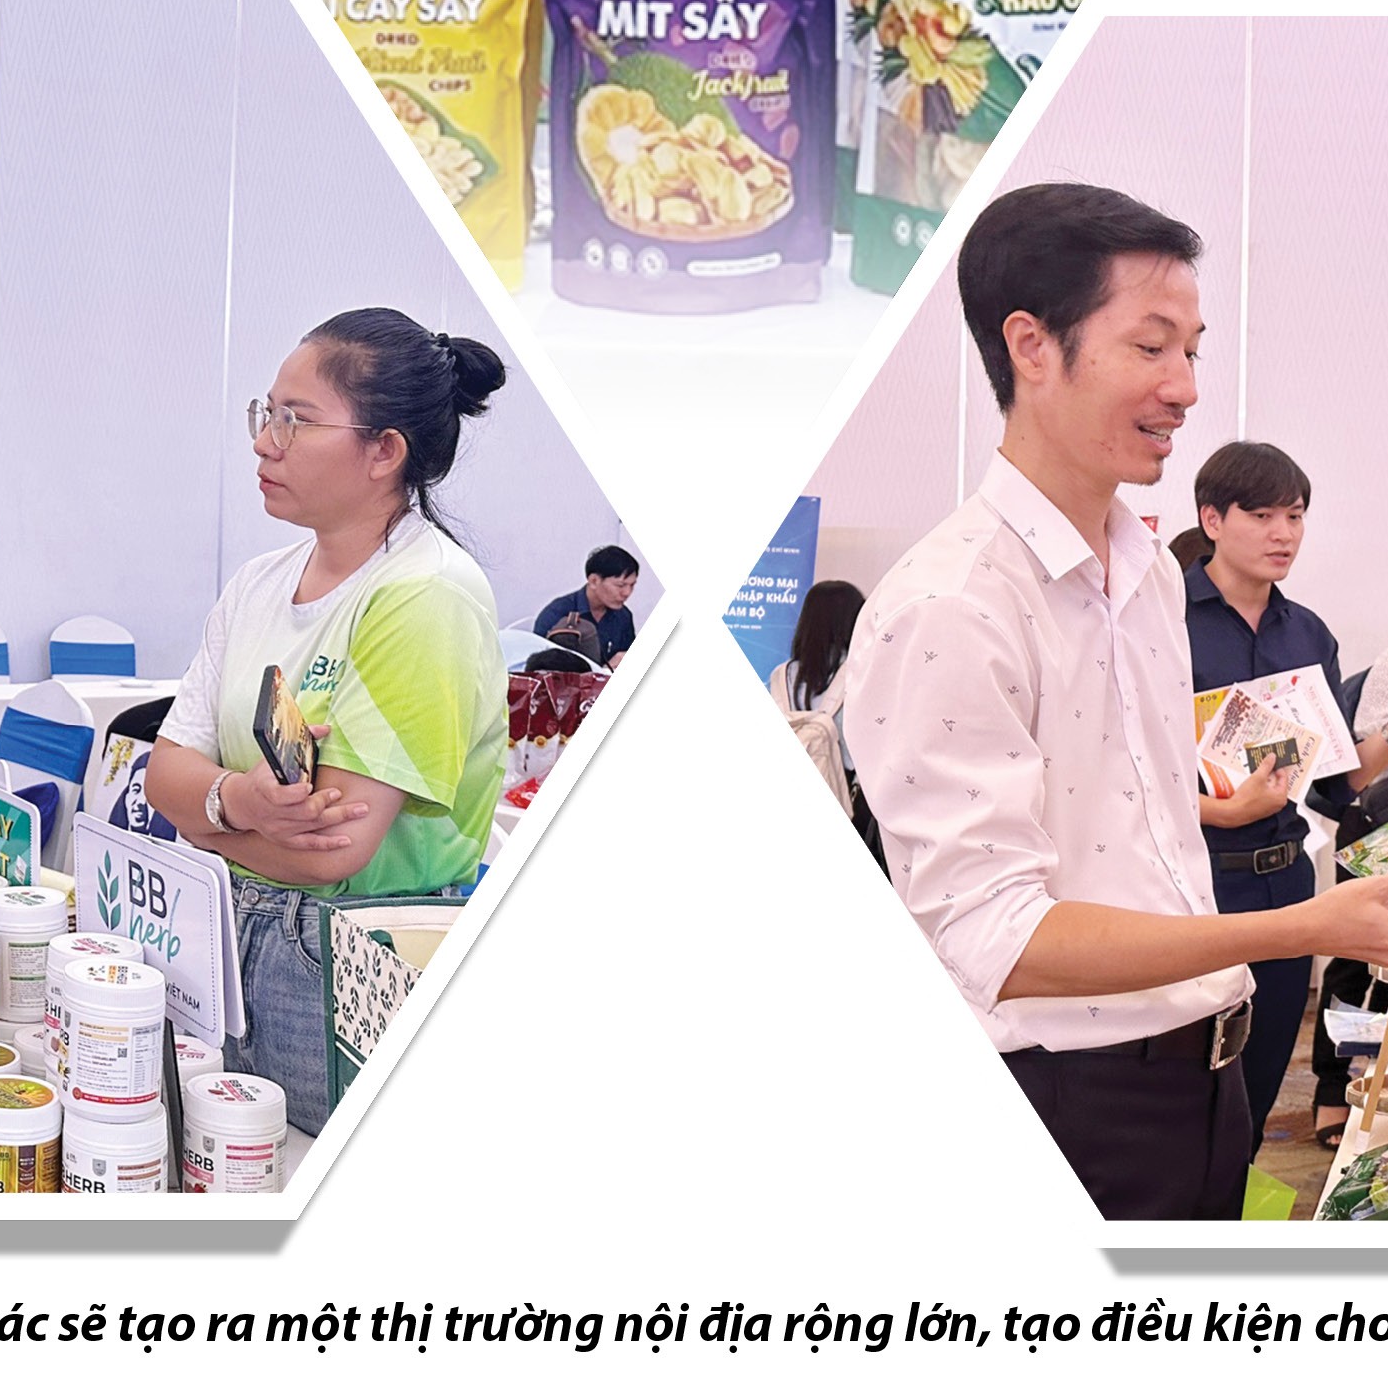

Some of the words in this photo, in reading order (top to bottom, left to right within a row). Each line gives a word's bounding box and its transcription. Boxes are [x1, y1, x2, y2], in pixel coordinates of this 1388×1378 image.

[376, 33, 419, 45] DRIED
[429, 80, 471, 92] CHIPS
[687, 70, 789, 101] Jackfruit
[749, 606, 765, 620] BỘ
[129, 859, 167, 920] BB
[129, 887, 181, 964] herb
[182, 992, 201, 1012] NAM
